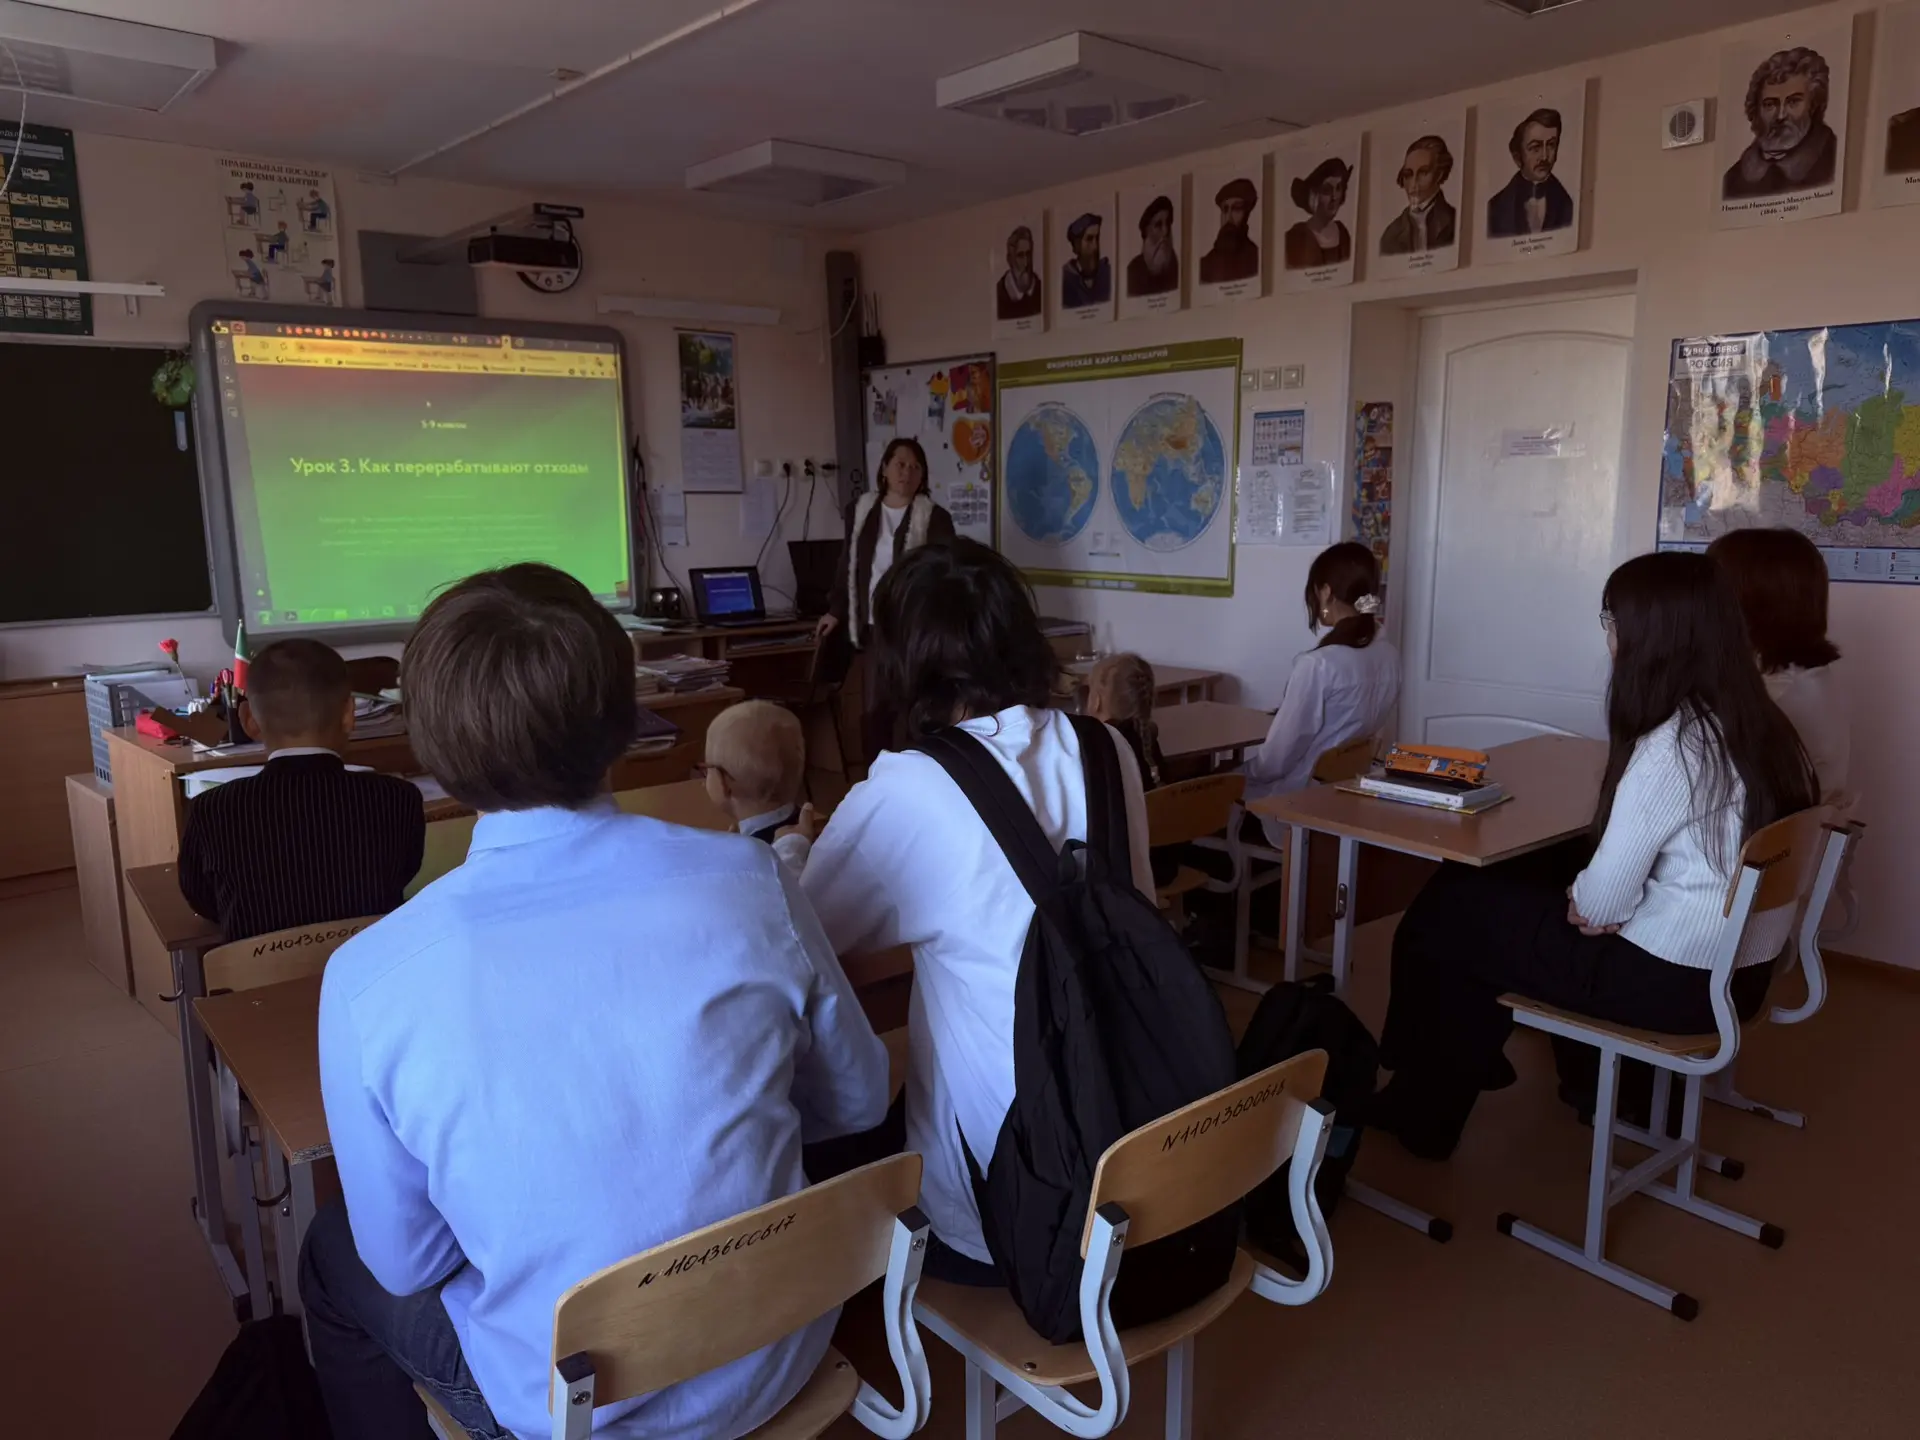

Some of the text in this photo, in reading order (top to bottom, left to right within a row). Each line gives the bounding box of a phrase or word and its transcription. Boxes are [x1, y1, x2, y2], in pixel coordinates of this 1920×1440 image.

[220, 158, 283, 174] ПРАВИЛЬНАЯ
[231, 170, 243, 178] ВО
[245, 172, 275, 182] ВРЕМЯ
[1692, 344, 1739, 356] BRAUBERG
[1095, 354, 1120, 365] КАРТА
[1689, 357, 1734, 369] РОССИЯ
[290, 457, 589, 476] Урок 3. Как перерабатывают отходы
